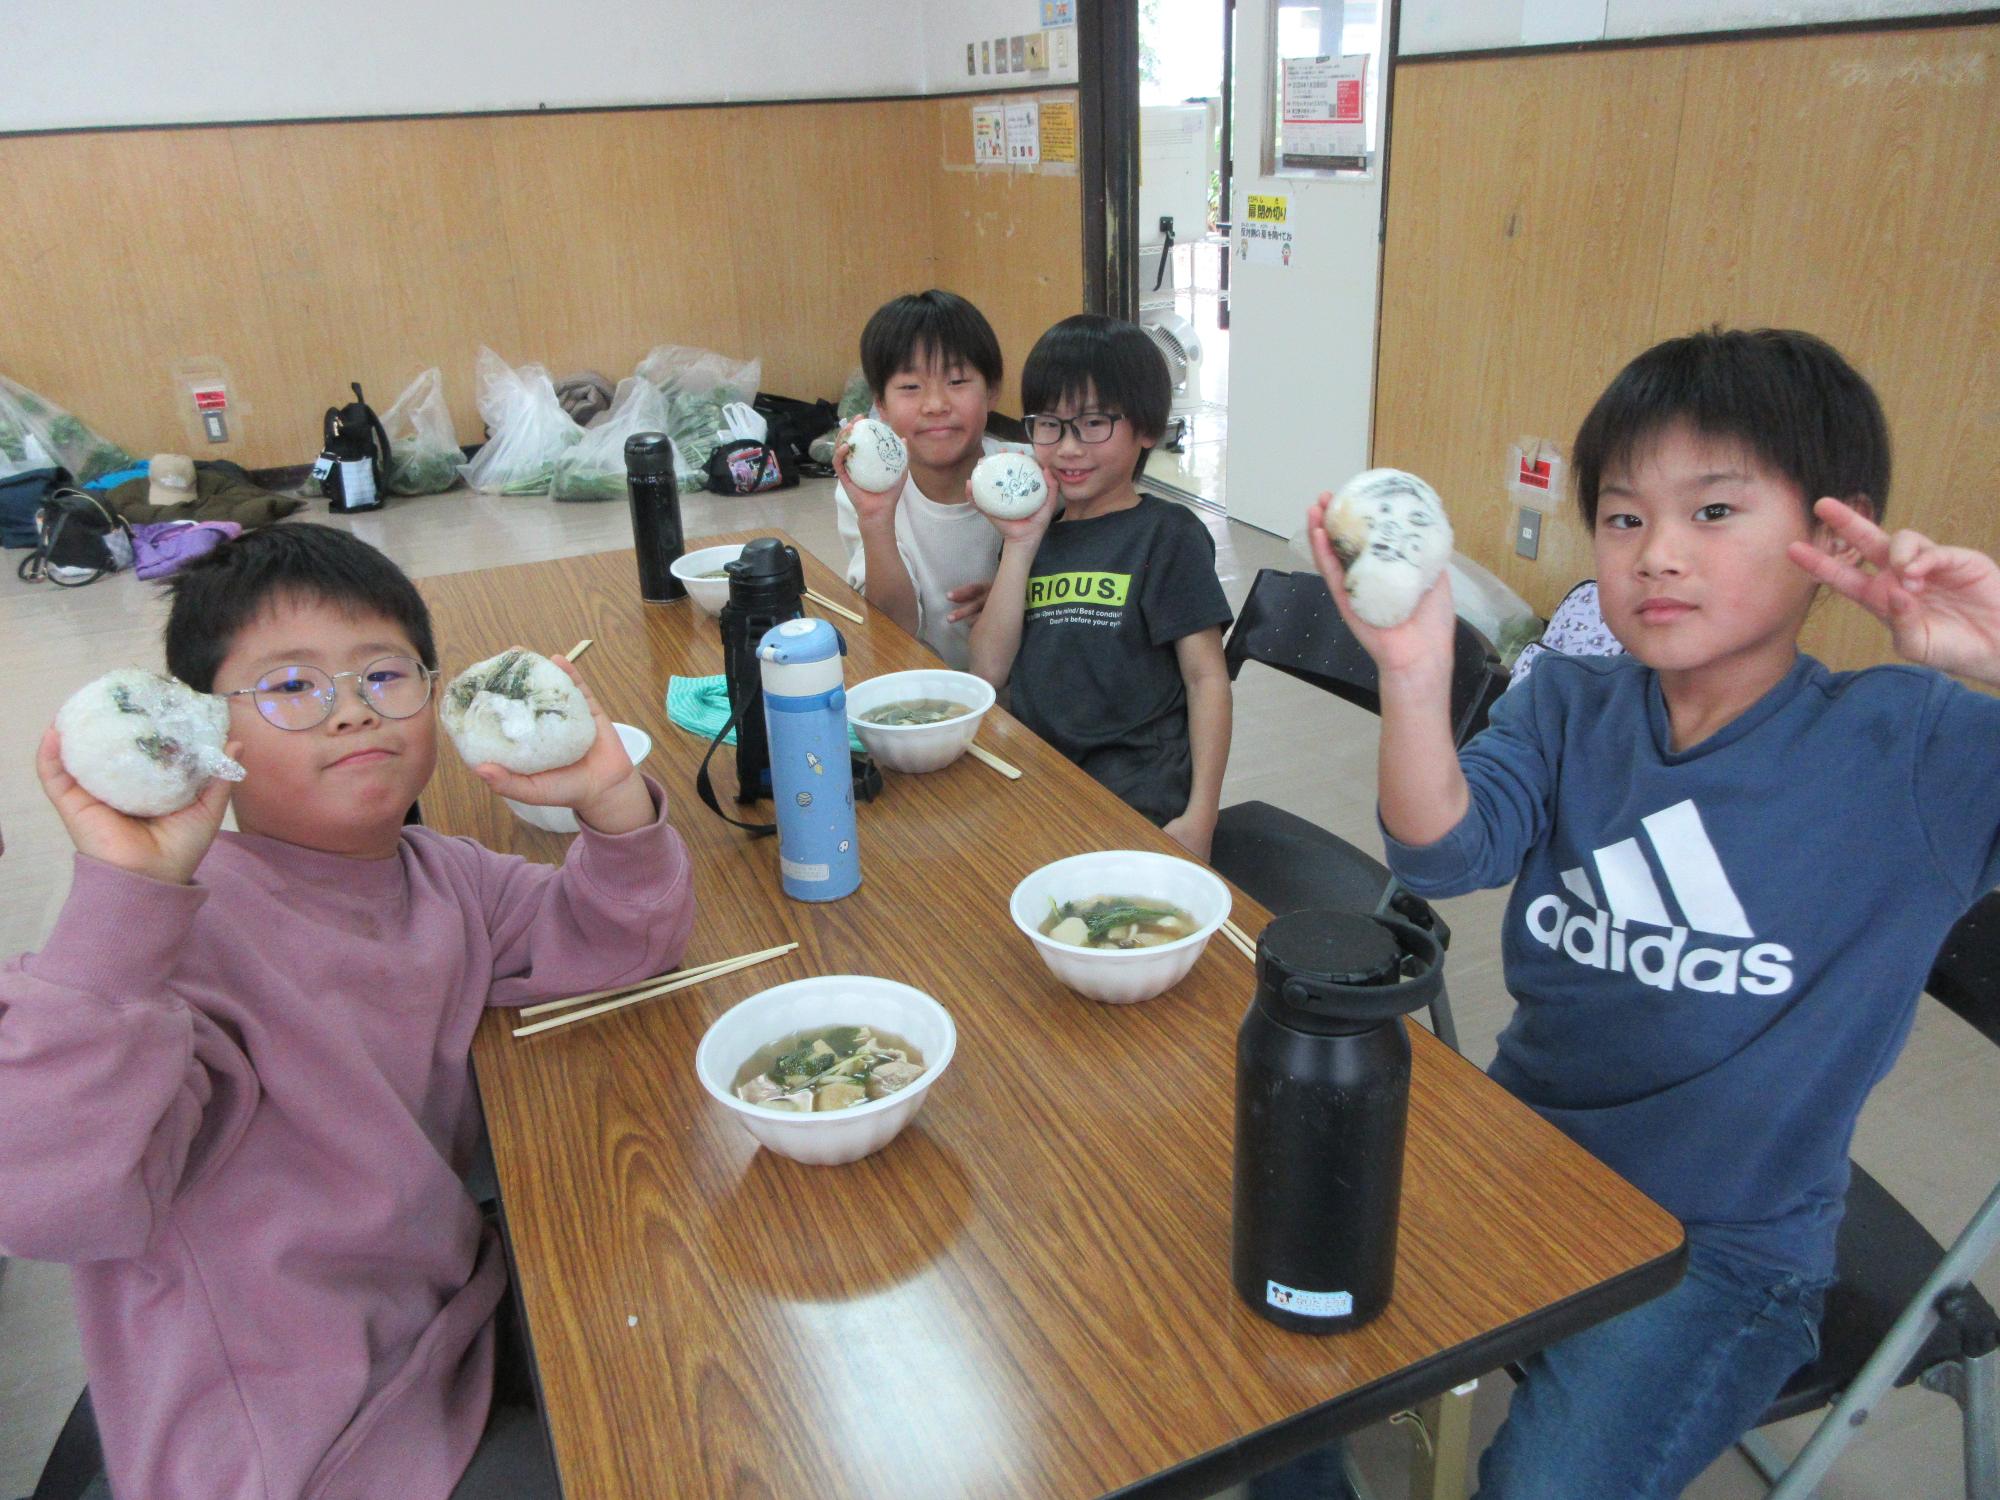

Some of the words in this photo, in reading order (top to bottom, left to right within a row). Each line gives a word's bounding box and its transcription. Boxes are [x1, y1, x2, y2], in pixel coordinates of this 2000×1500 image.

[1029, 577, 1122, 602] RIOUS.
[1070, 615, 1091, 624] before
[1092, 619, 1109, 627] your
[1526, 894, 1794, 995] adidas
